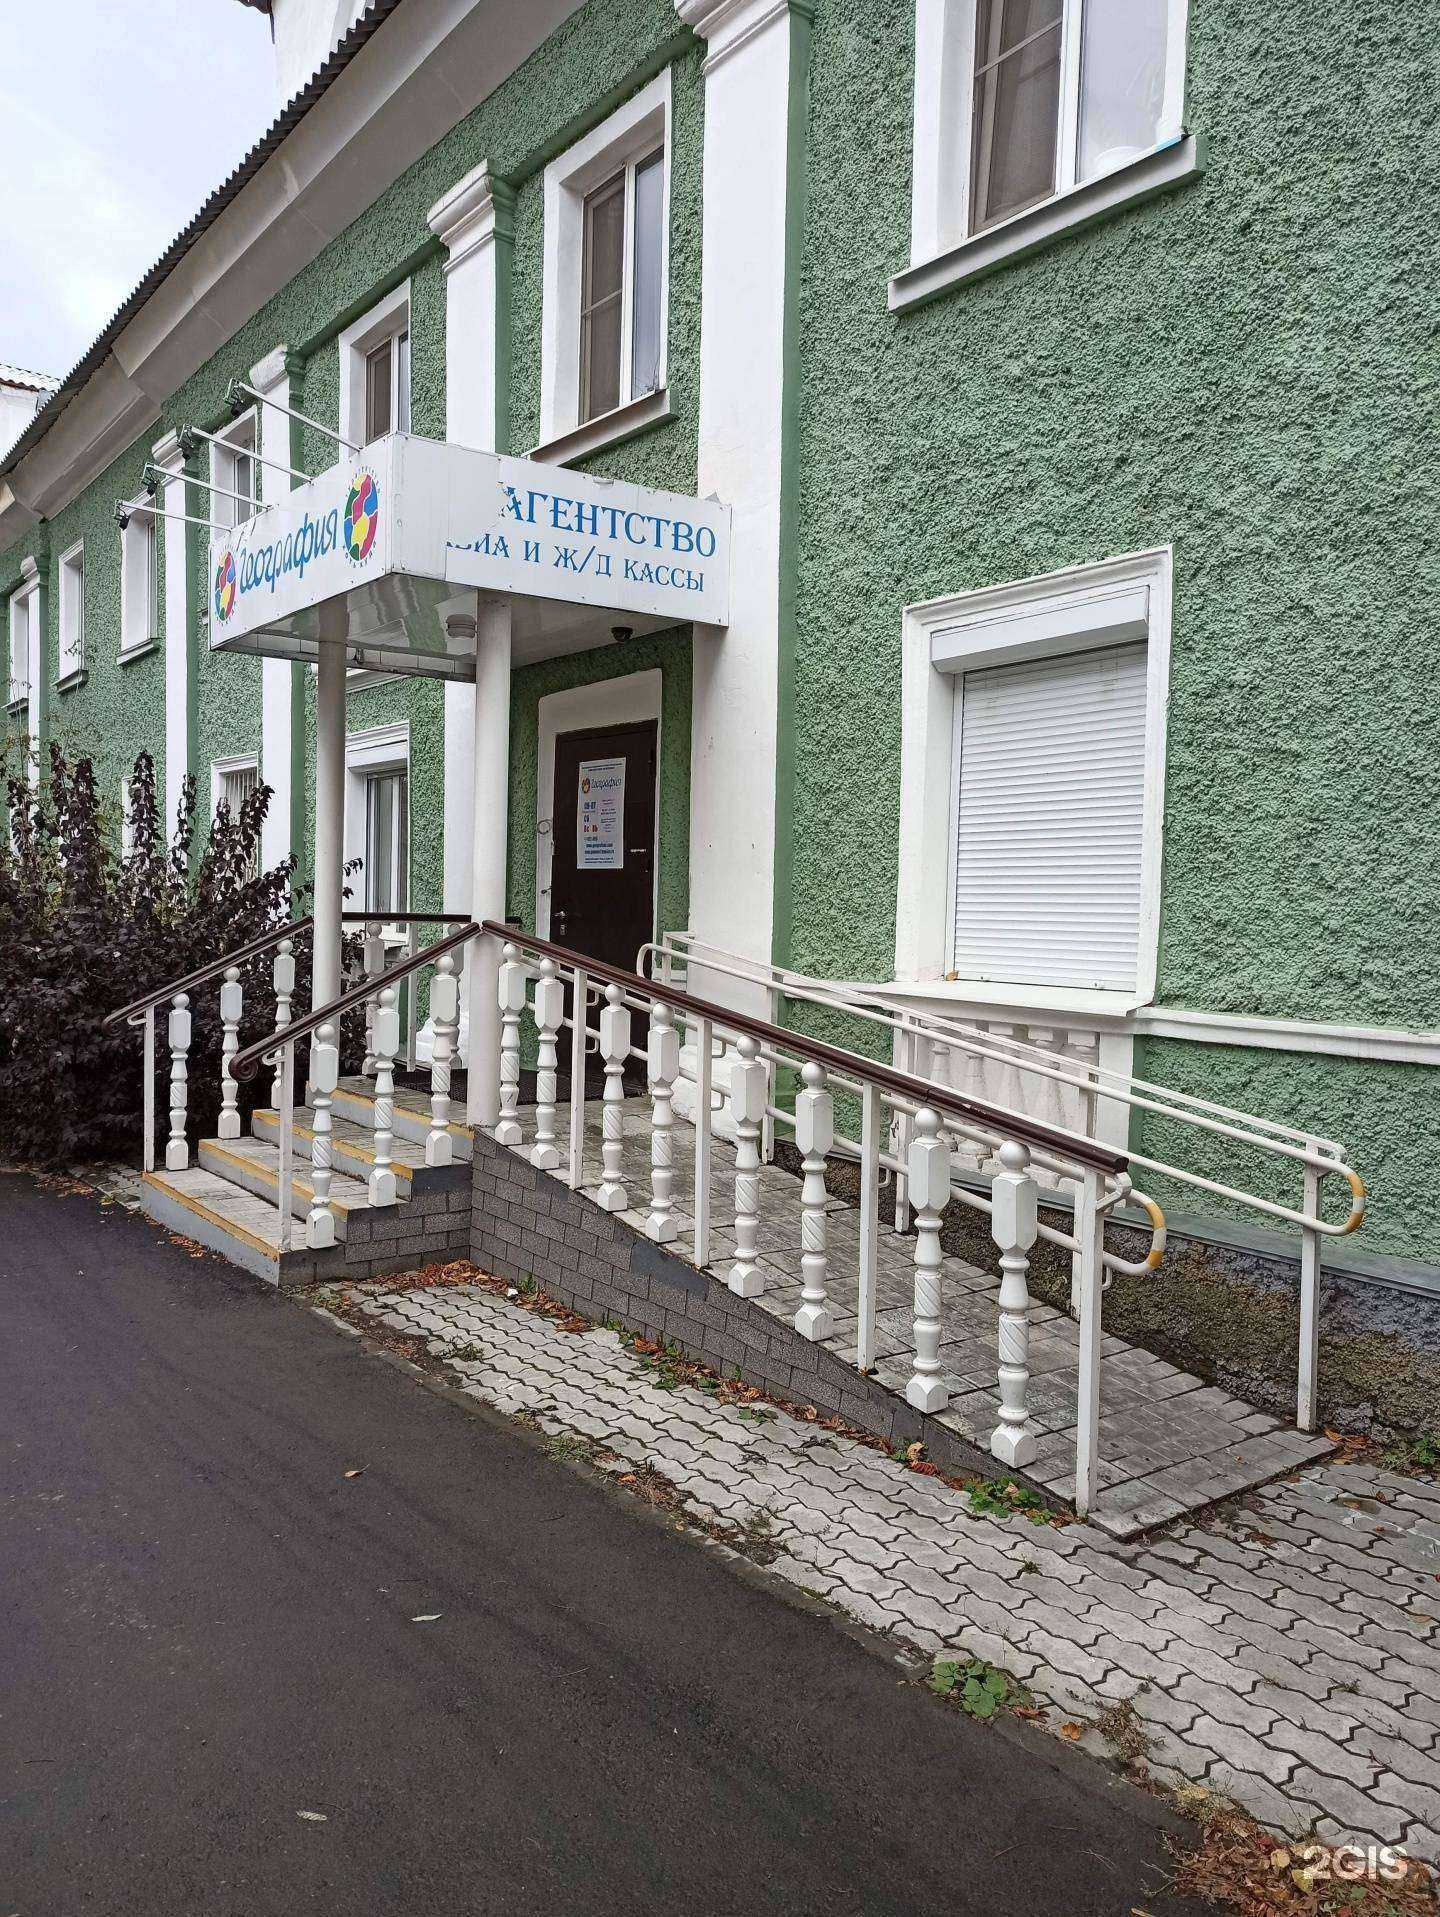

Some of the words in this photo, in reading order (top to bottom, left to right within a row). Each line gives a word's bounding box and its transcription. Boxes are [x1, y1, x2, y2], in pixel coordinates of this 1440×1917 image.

[523, 539, 541, 563] И
[553, 545, 612, 577] Ж/Д
[624, 558, 705, 592] КАССЫ
